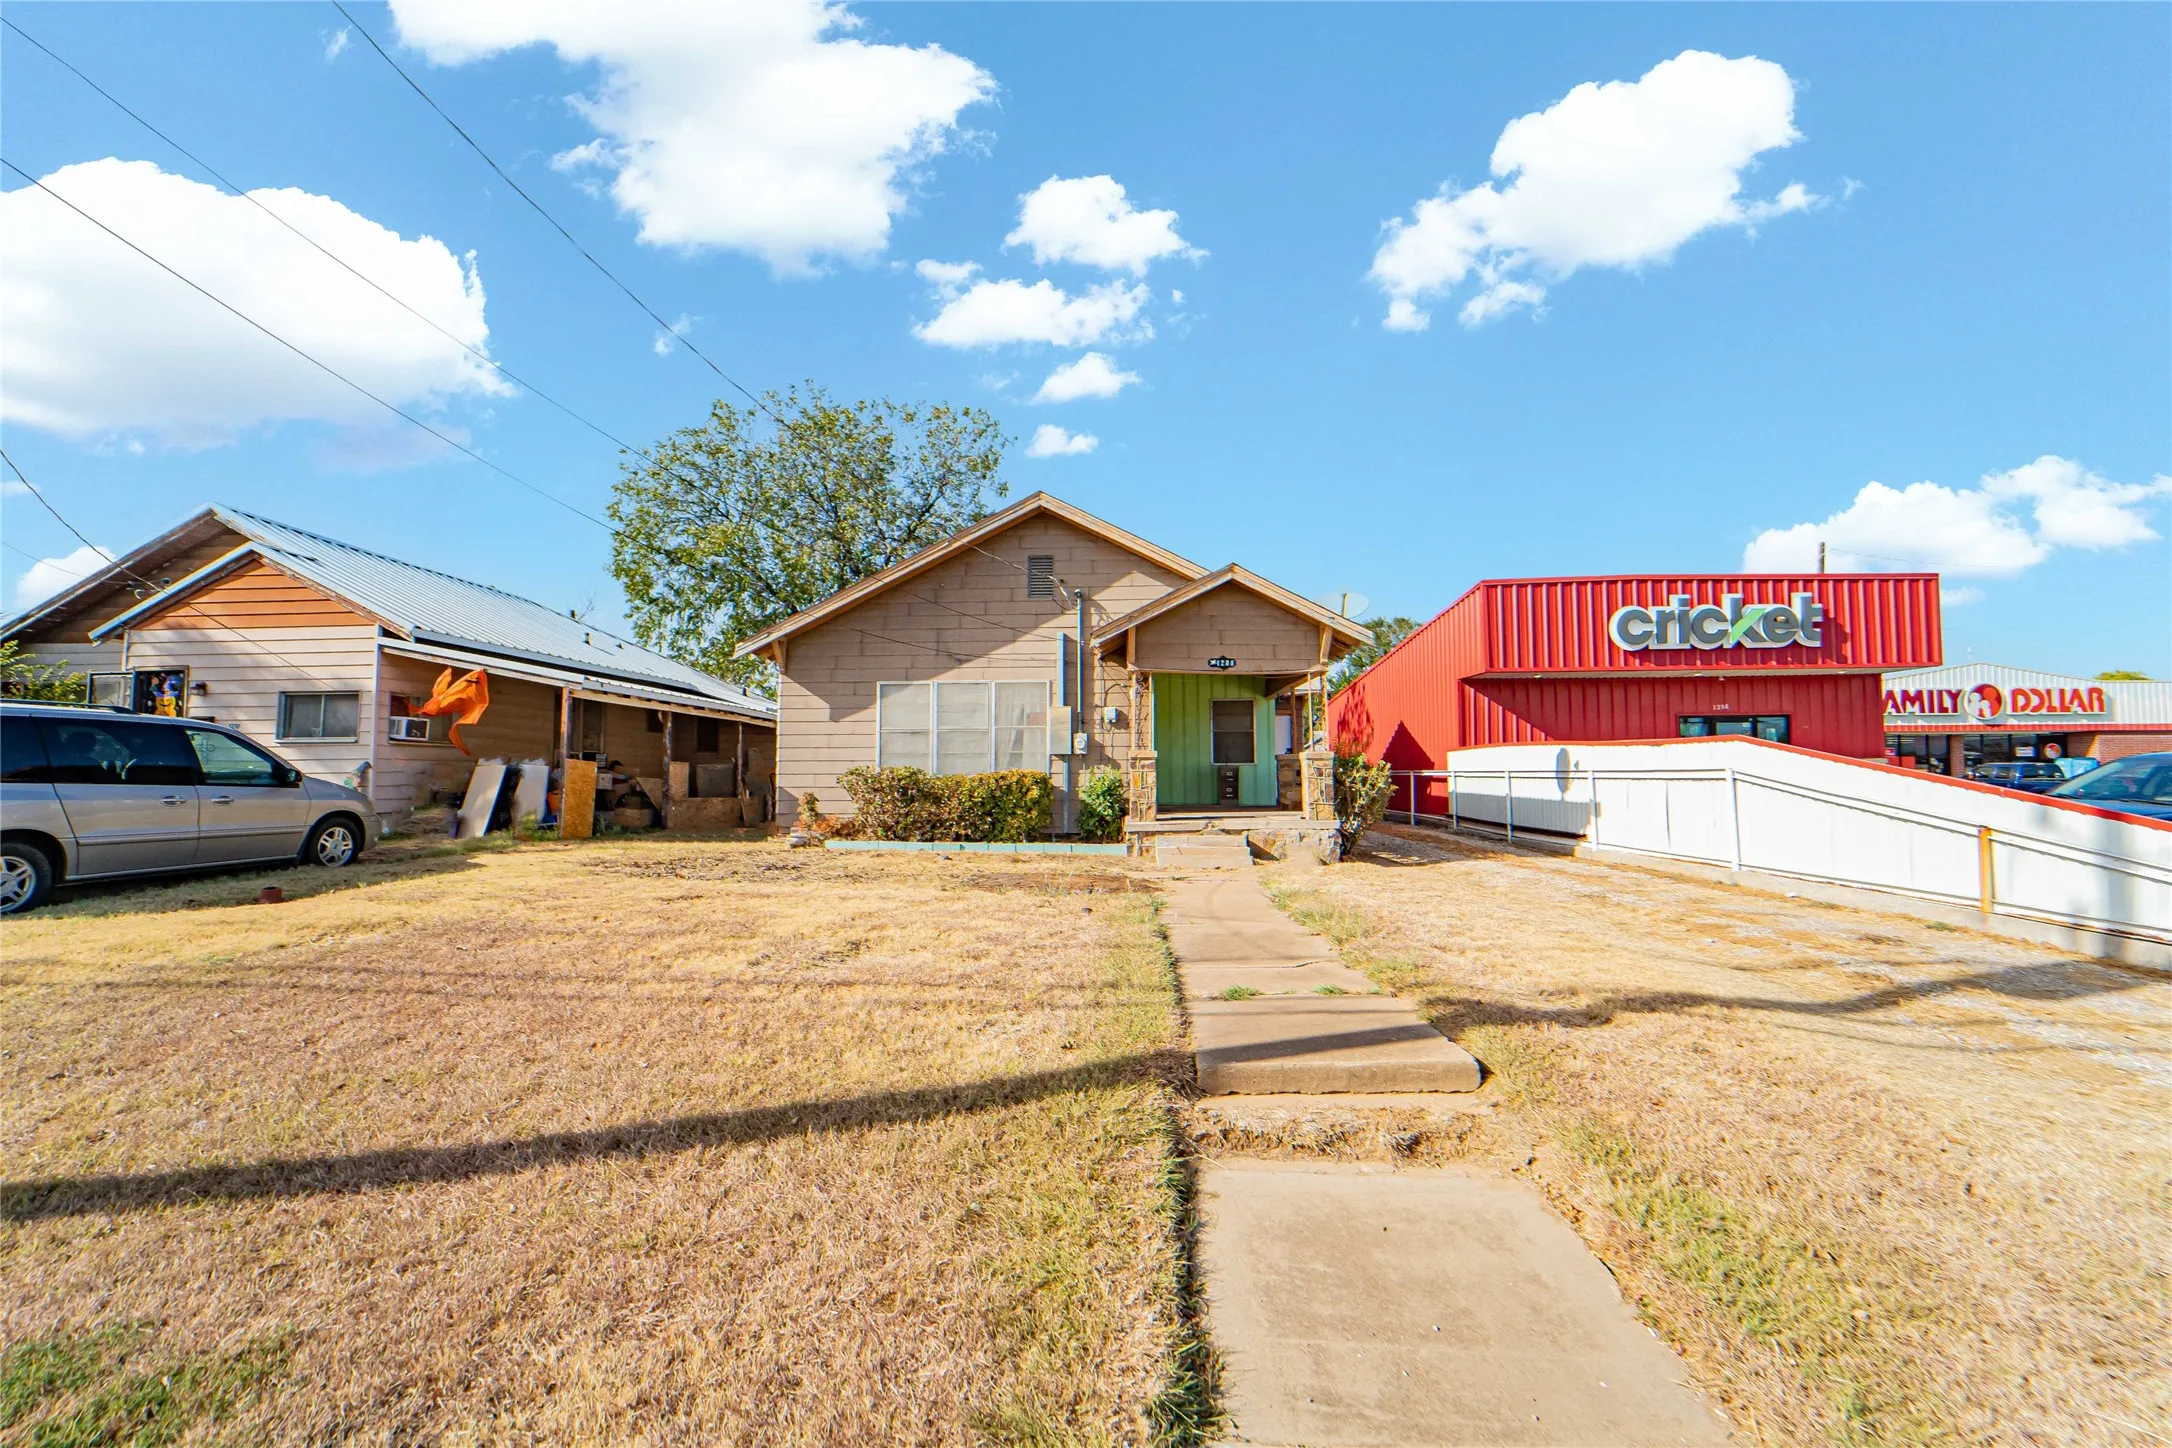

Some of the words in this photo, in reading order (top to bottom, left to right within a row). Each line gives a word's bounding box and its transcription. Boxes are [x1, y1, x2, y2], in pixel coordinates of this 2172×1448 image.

[1612, 594, 1823, 649] cricket
[1882, 689, 1963, 714] AMILY
[2010, 687, 2105, 713] DOLLAR
